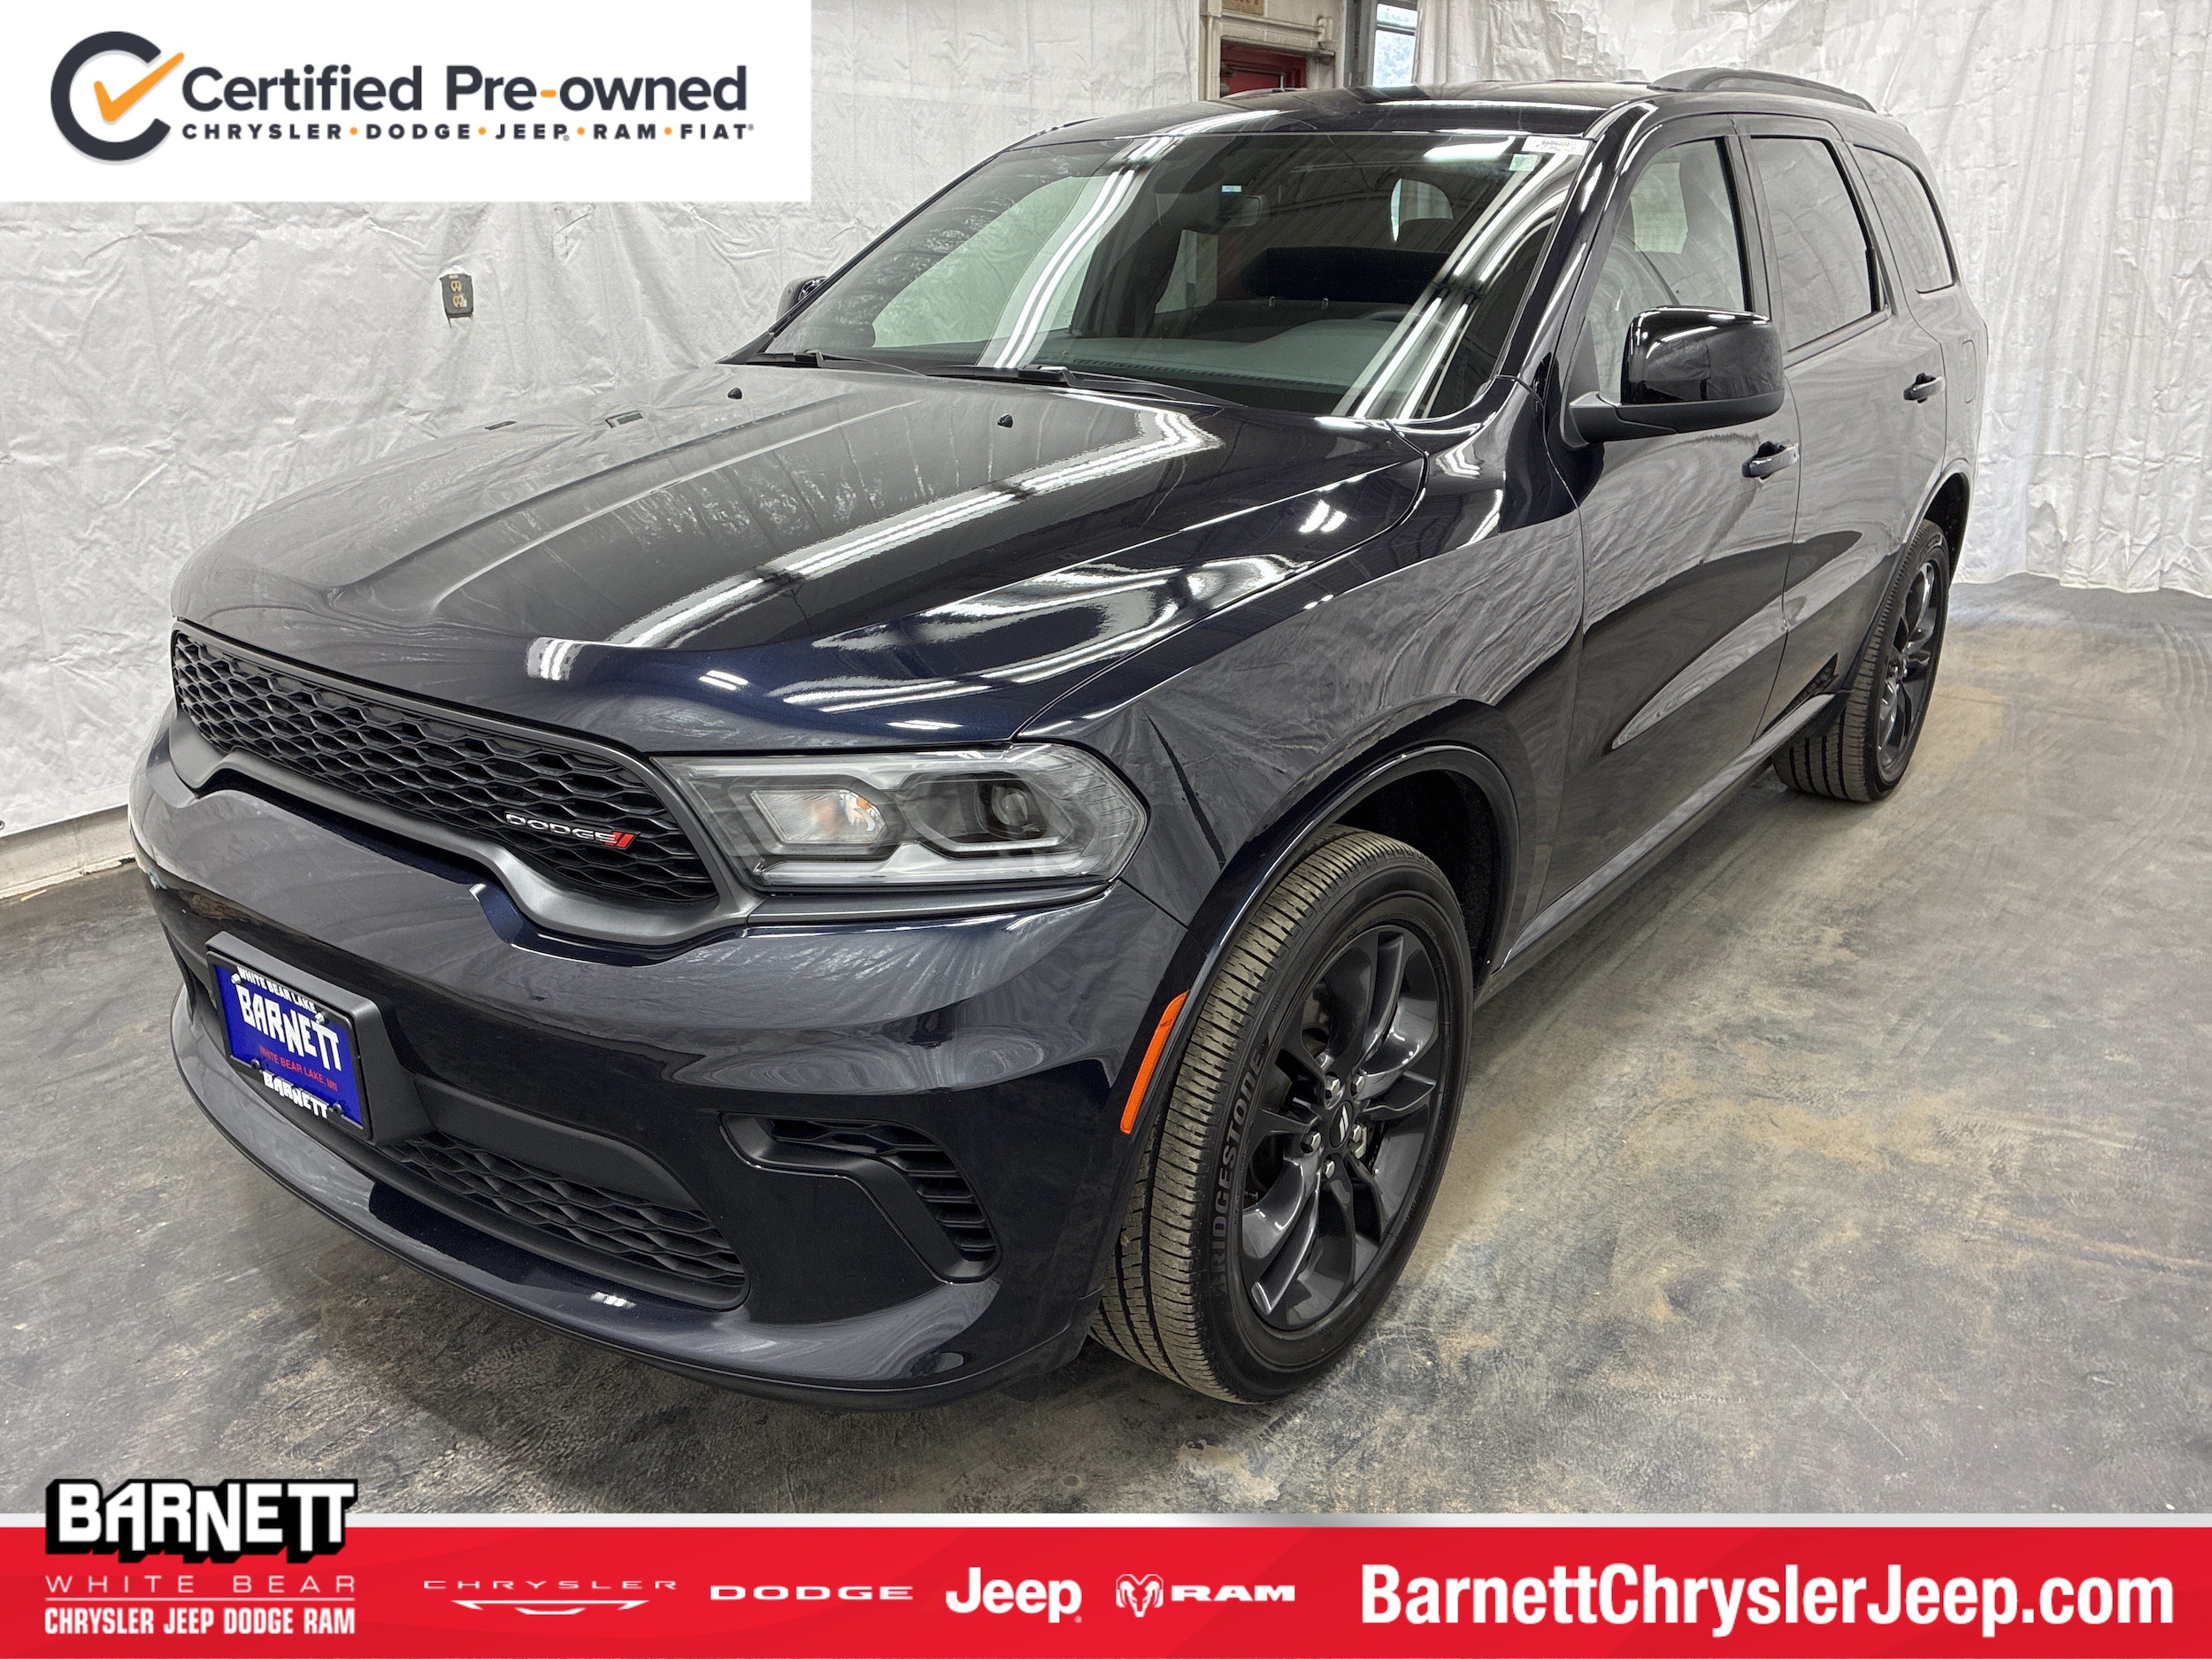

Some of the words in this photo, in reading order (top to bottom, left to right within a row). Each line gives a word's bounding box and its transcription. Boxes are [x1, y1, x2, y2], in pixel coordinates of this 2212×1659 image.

[505, 813, 618, 844] DODGE
[236, 965, 267, 990] WHITE
[266, 979, 292, 1002] BEAR
[291, 992, 318, 1015] LAKE
[235, 984, 342, 1072] BARNETT
[280, 1056, 303, 1074] BEAR
[262, 1070, 330, 1119] BARNETT
